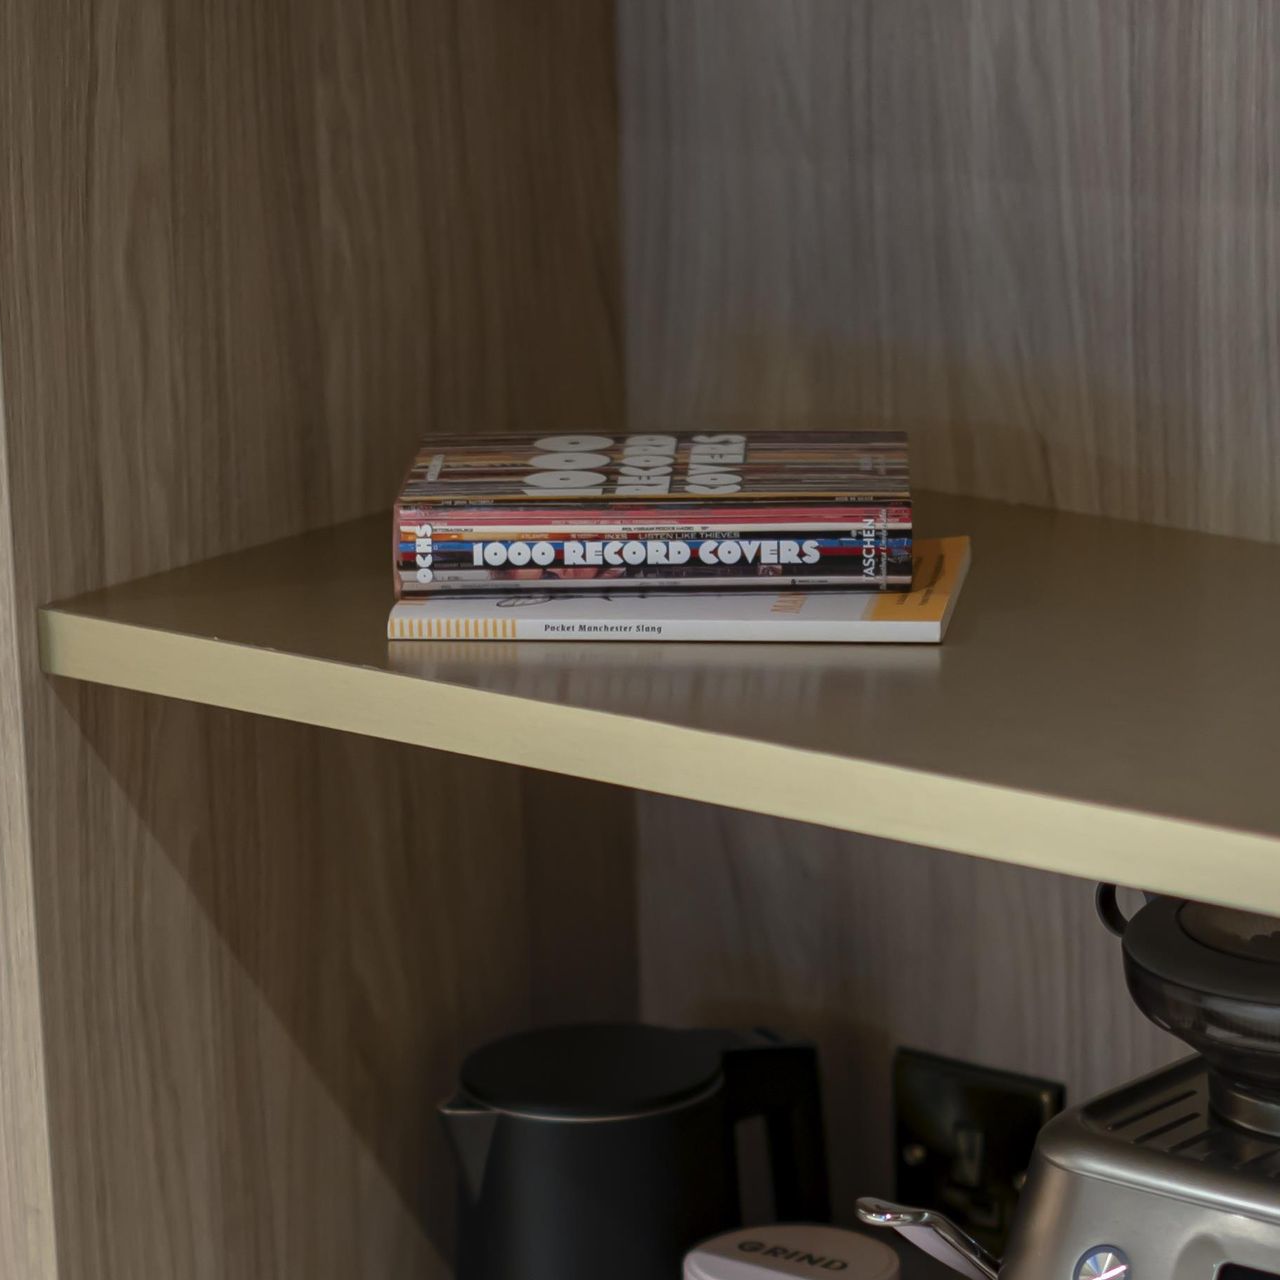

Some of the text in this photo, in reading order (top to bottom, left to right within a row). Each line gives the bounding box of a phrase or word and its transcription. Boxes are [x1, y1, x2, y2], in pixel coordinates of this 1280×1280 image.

[522, 435, 615, 496] 1000
[615, 434, 678, 496] RECORD
[684, 434, 747, 494] COVERS
[415, 523, 433, 584] OCHS
[473, 540, 821, 566] 1000 RECORD COVERS
[638, 532, 673, 540] LISTEN
[699, 530, 741, 539] THIEVES
[862, 517, 876, 581] TASCHEN
[544, 624, 663, 634] Pocket Manchester Slang
[737, 1241, 849, 1271] GRIND
